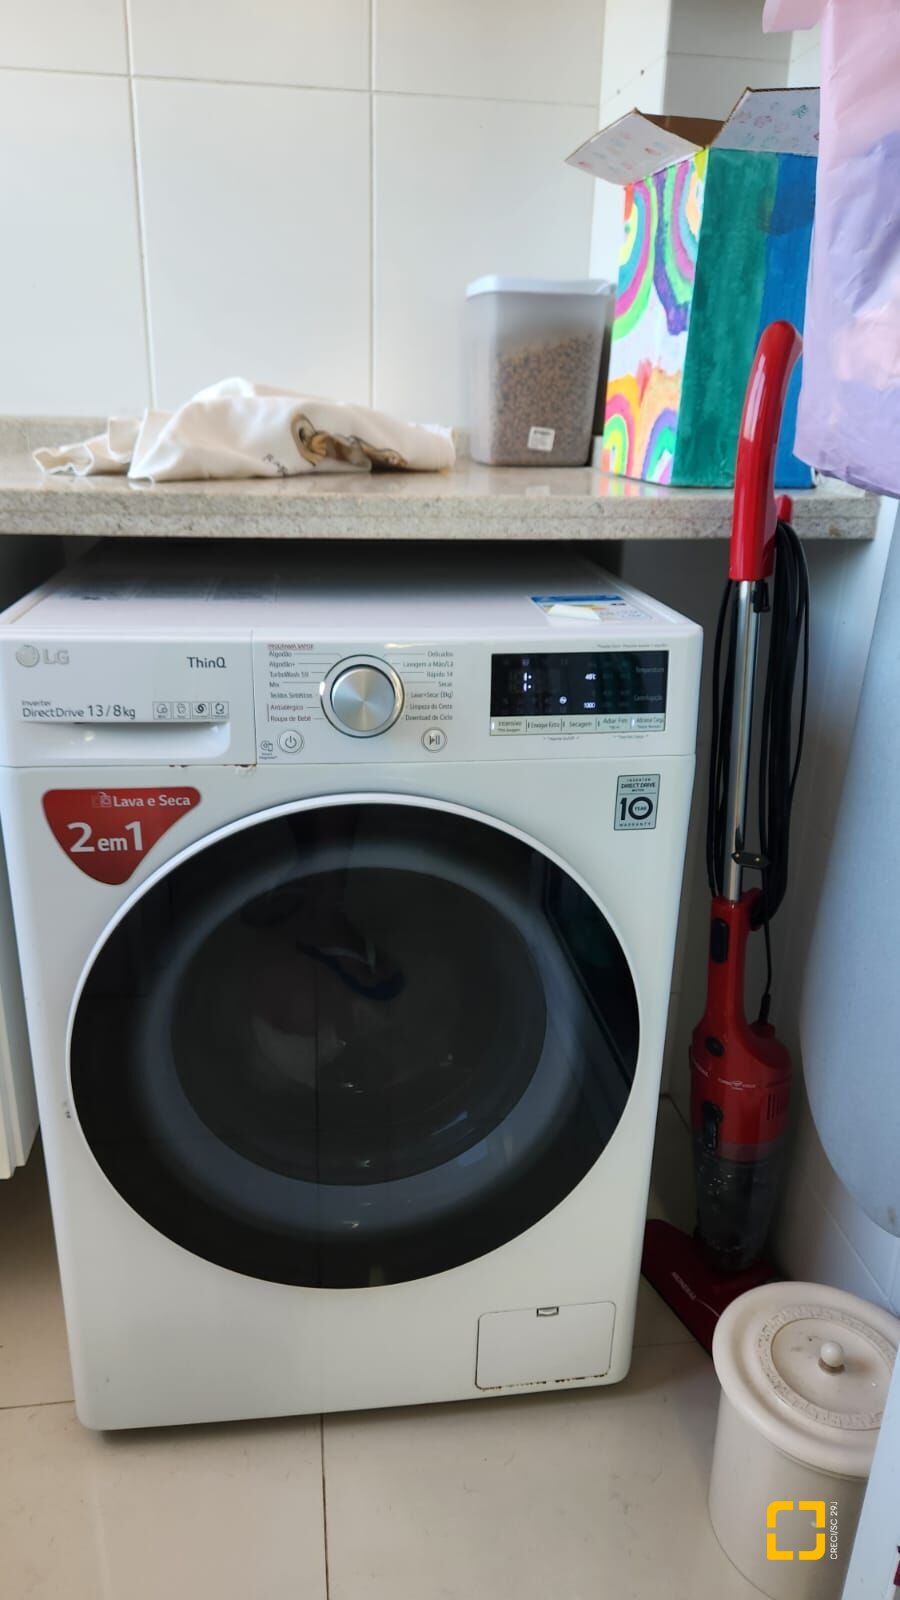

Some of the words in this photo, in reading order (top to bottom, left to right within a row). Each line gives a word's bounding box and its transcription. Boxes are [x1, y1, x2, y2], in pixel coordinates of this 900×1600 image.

[44, 648, 70, 665] LG
[269, 650, 292, 658] Algodão
[186, 656, 227, 669] ThinQ
[403, 661, 427, 669] Lavagem
[21, 699, 51, 707] Inverter
[270, 715, 288, 723] Roupa
[569, 720, 593, 729] Secagem
[113, 796, 144, 808] Lava
[147, 798, 156, 807] e
[159, 794, 191, 807] Seca
[620, 796, 654, 821] 10
[66, 821, 95, 853] 2
[97, 836, 128, 852] em
[125, 820, 143, 851] 1
